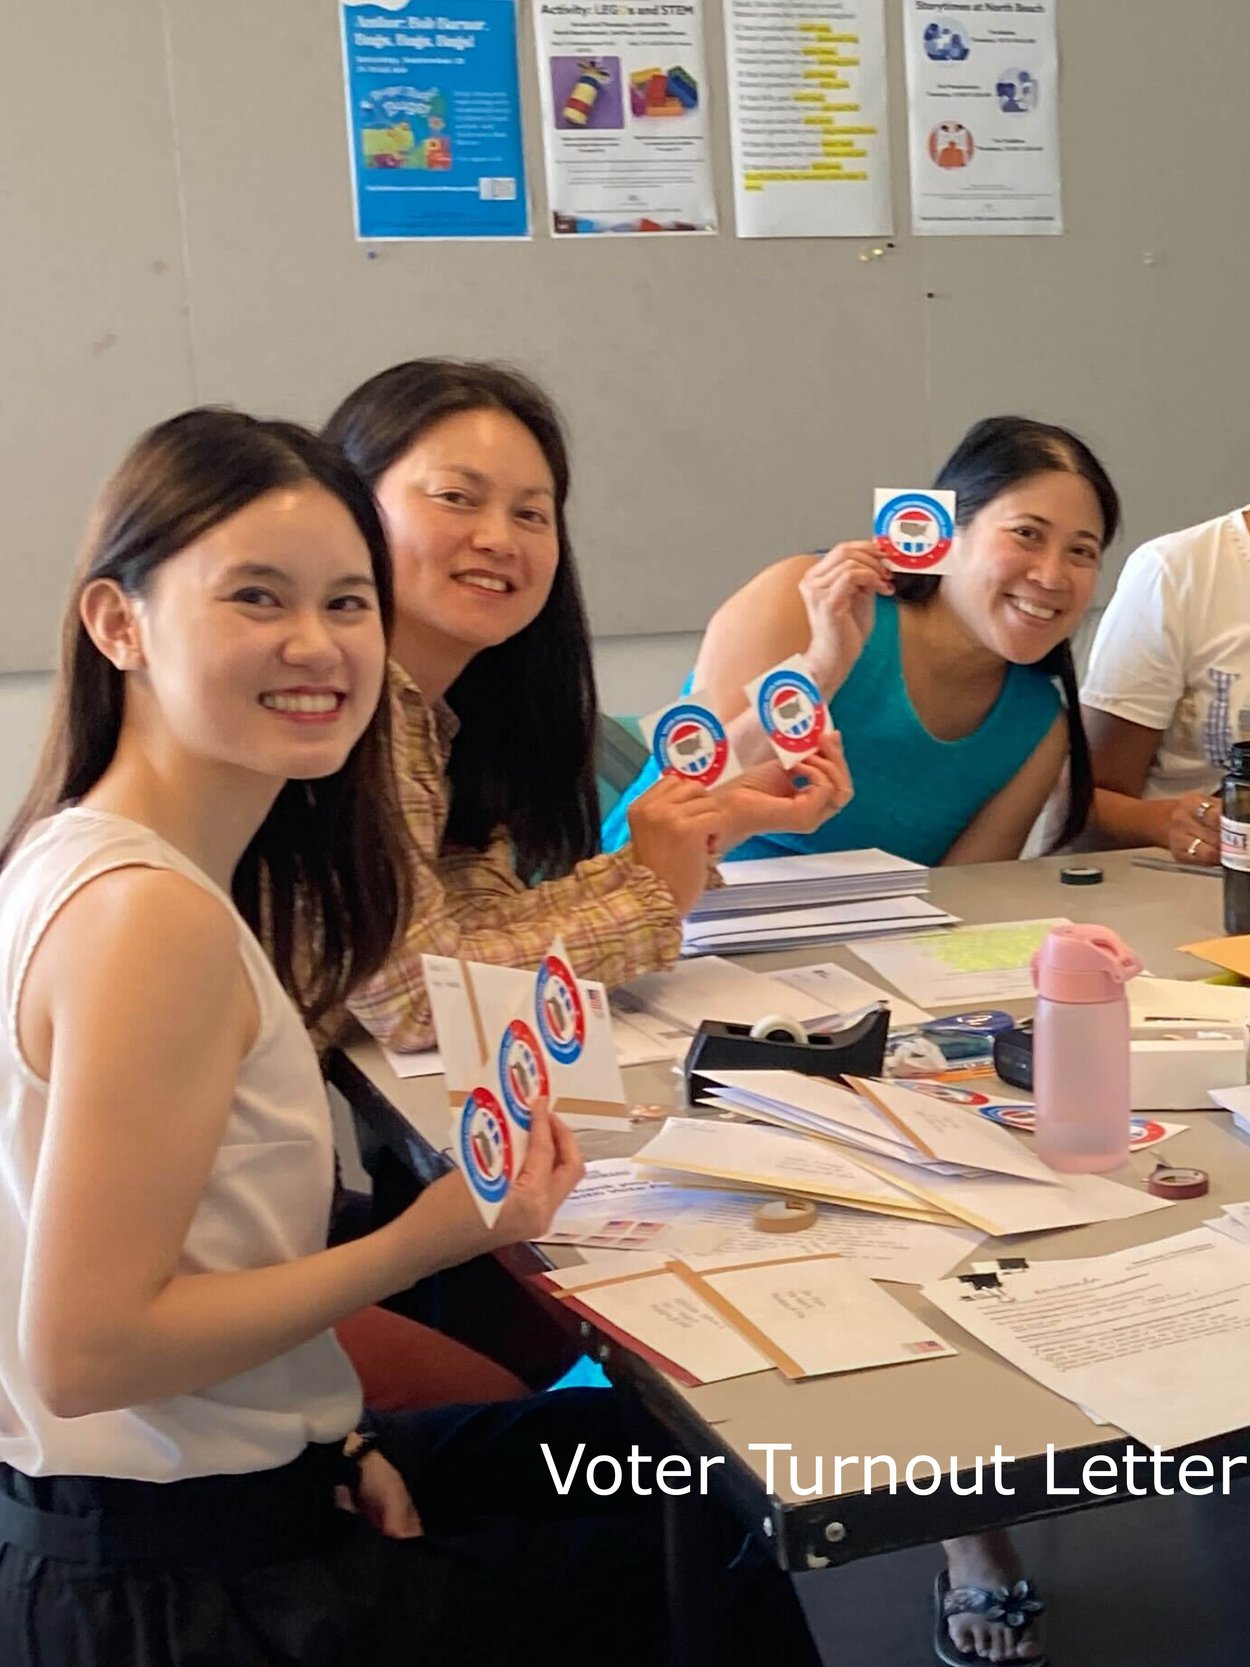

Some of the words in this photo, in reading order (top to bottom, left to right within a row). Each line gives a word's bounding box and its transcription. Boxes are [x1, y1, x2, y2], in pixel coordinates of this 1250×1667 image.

[540, 4, 592, 17] Activity:
[637, 5, 659, 15] and
[660, 5, 695, 15] STEM
